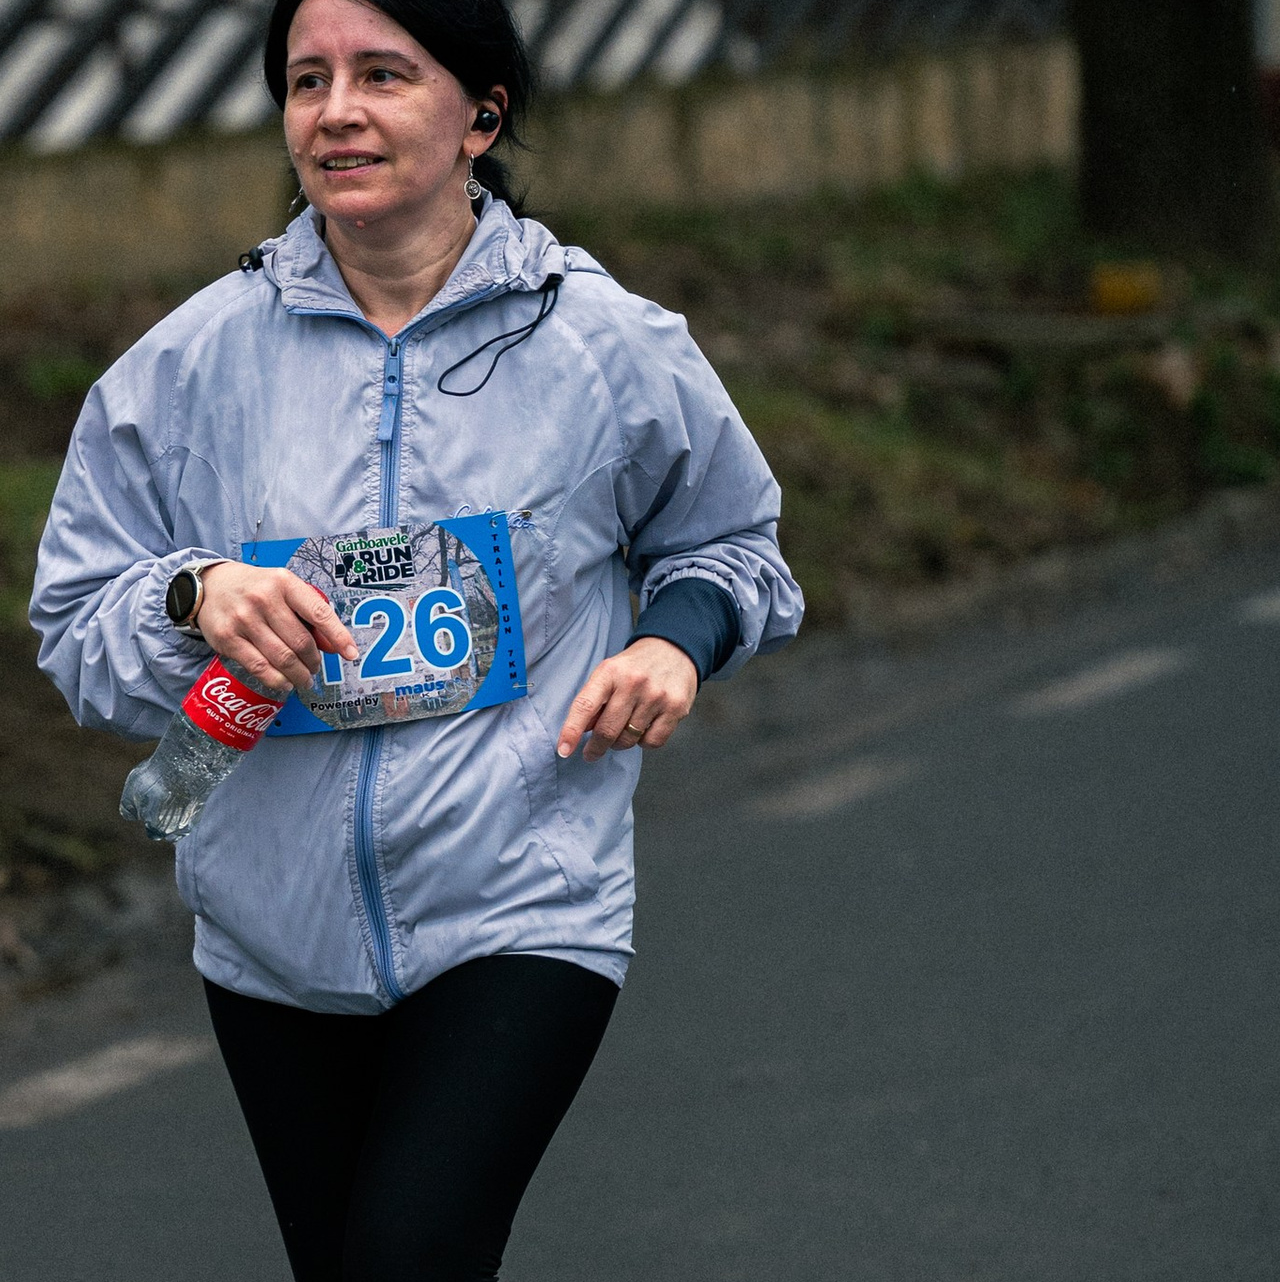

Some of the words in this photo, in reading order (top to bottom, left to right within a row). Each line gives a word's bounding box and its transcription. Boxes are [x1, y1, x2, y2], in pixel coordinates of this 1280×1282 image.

[335, 532, 409, 553] Gârboavele
[353, 559, 367, 574] &
[359, 545, 413, 567] RUN
[362, 562, 415, 584] RIDE
[491, 533, 505, 588] TRAIL
[502, 604, 512, 634] RUN
[508, 649, 517, 680] 7KM
[394, 680, 446, 697] maus
[311, 696, 364, 711] Powered
[365, 695, 379, 707] by
[206, 708, 224, 723] GUST
[224, 721, 256, 739] ORIGINAL
